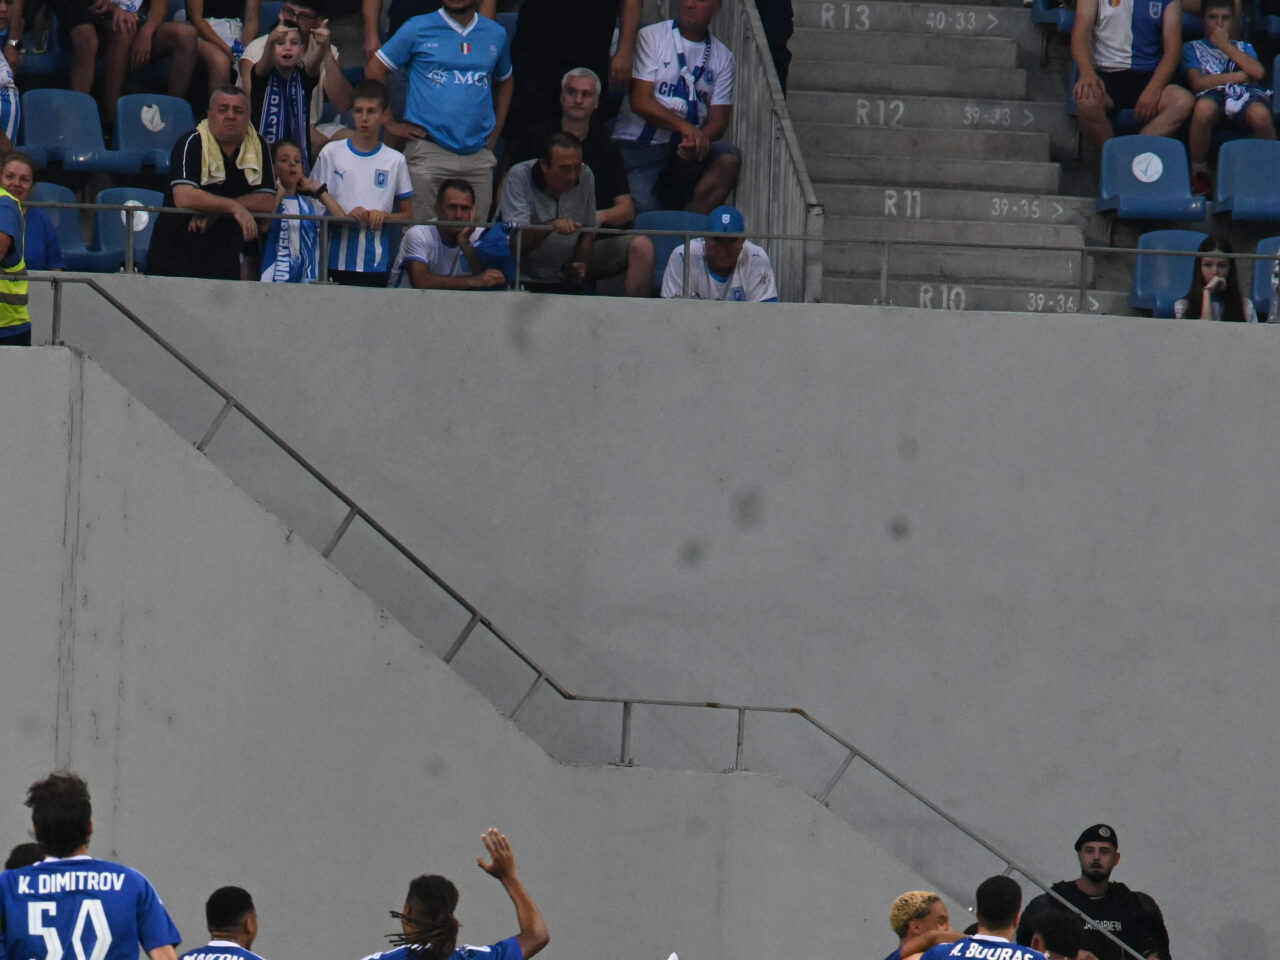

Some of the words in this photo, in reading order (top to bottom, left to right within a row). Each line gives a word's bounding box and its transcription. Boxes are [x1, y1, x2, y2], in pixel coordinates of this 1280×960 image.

[821, 4, 870, 31] R13
[855, 99, 904, 128] R12
[884, 189, 920, 218] R11
[920, 284, 966, 310] R10
[18, 875, 35, 894] K.
[38, 871, 125, 894] DIMITROV
